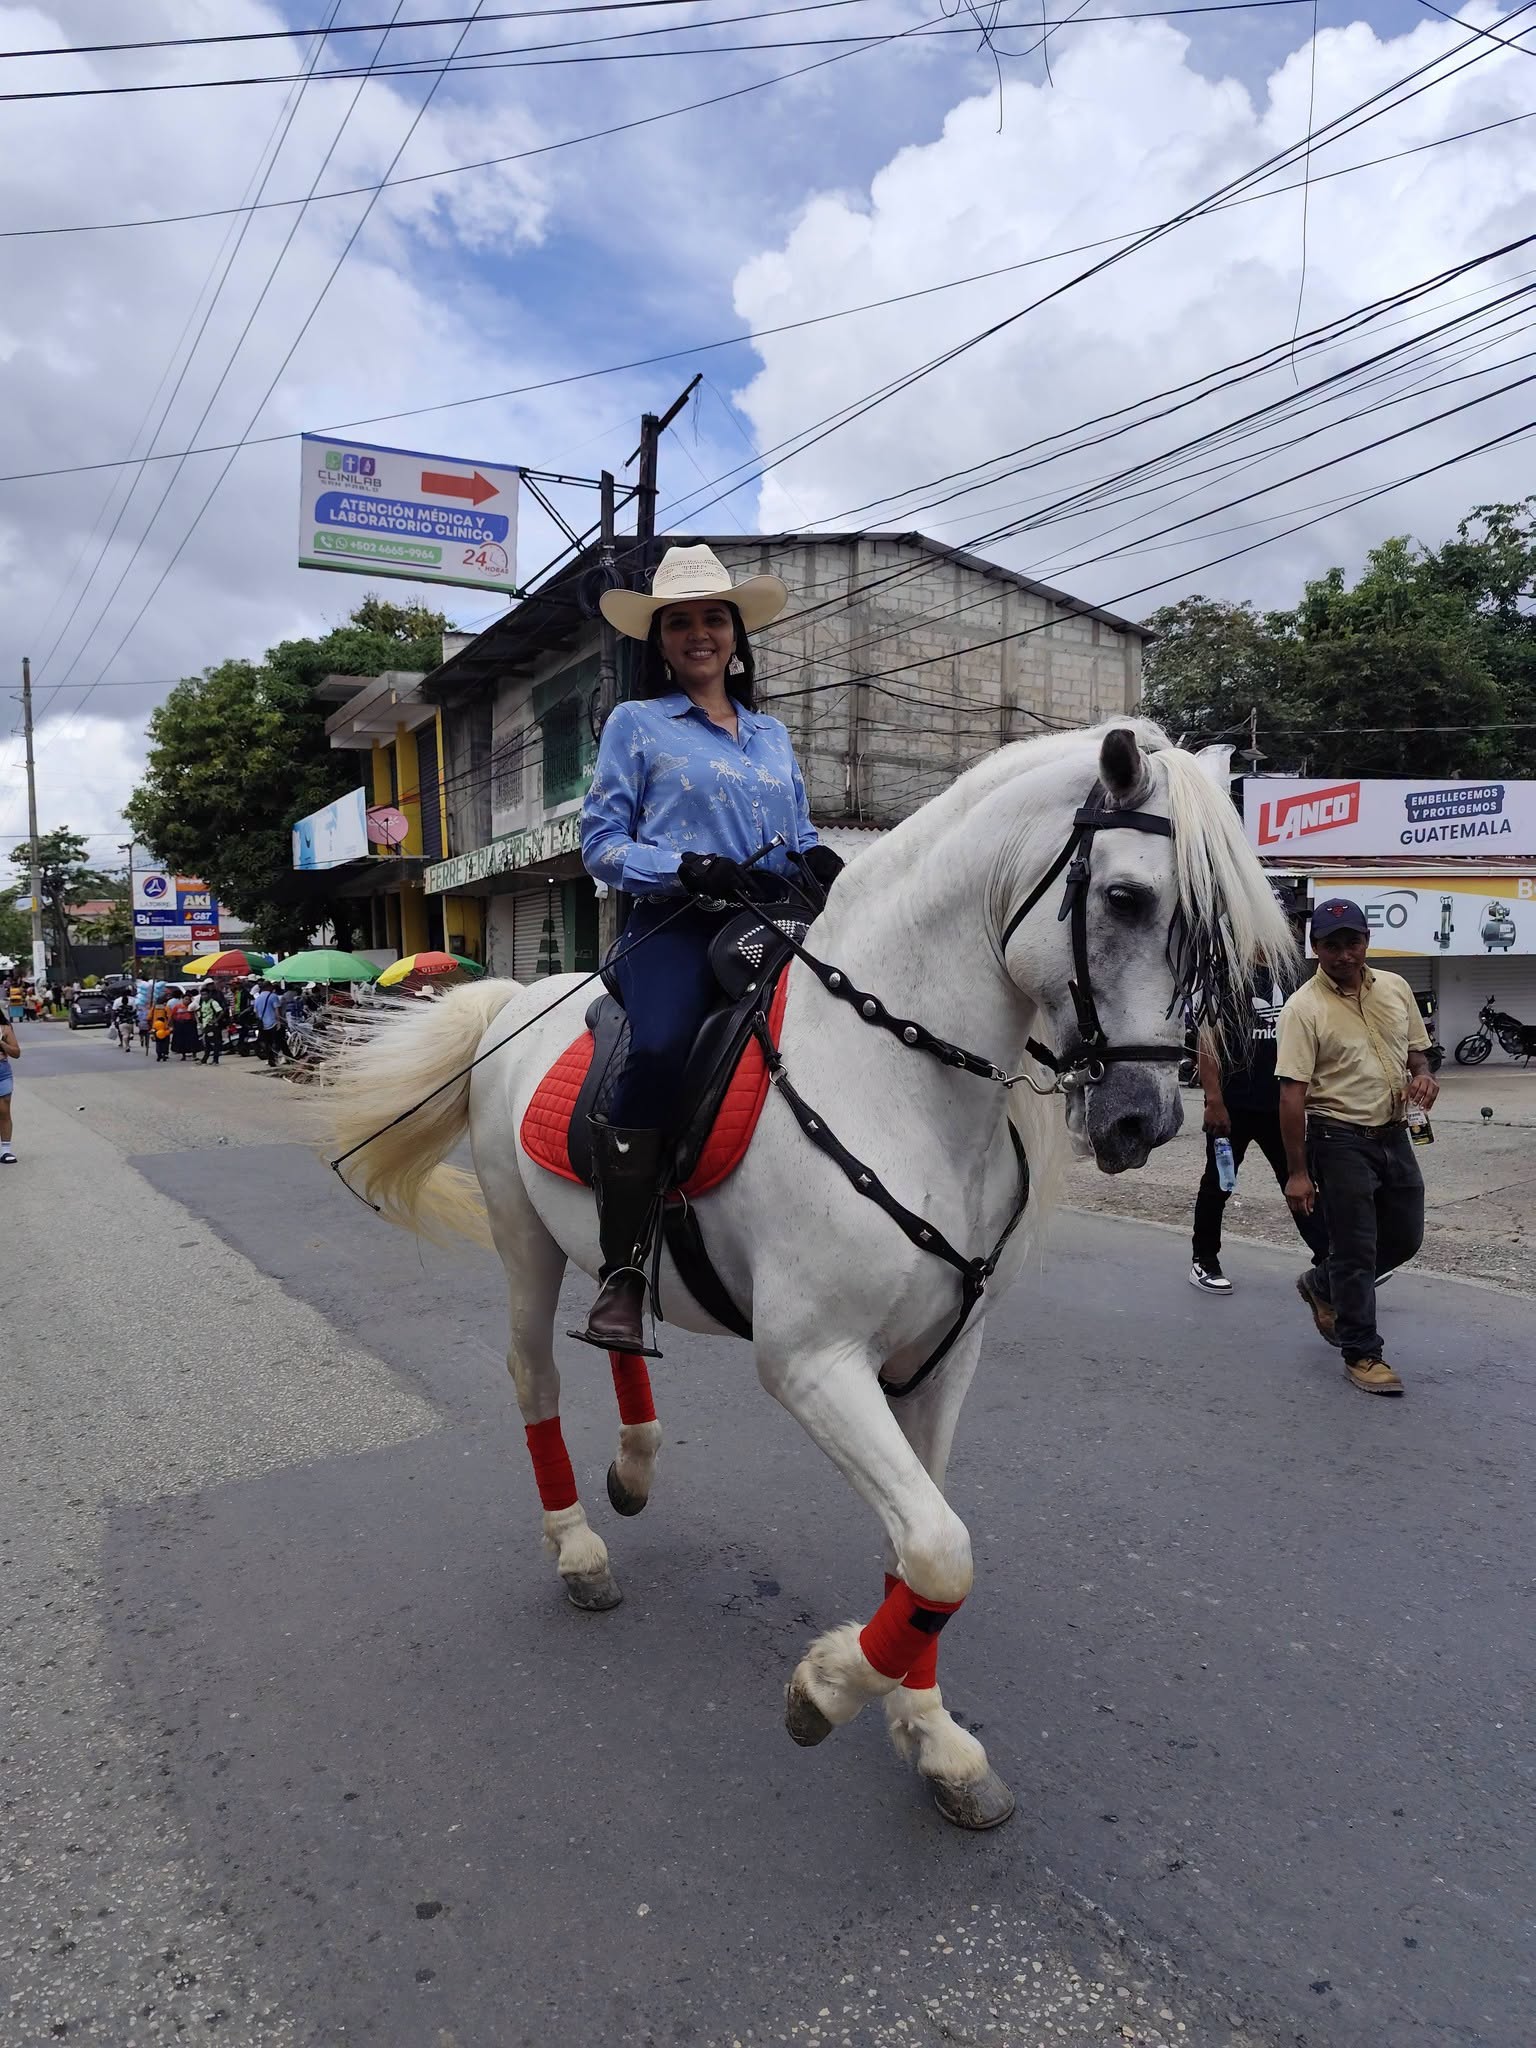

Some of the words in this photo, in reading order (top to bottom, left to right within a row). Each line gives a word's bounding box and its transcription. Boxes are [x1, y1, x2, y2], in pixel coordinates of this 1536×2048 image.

[318, 469, 382, 487] CLINILAB
[340, 497, 414, 519] ATENCIÓN
[417, 507, 473, 527] MÉDICA
[474, 517, 485, 529] Y
[330, 509, 432, 534] LABORATORIO
[435, 524, 494, 542] CLINICO
[350, 541, 377, 552] +502
[378, 543, 435, 560] 4665-9964
[462, 549, 488, 567] 24
[1411, 788, 1498, 806] EMBELLECEMOS
[1267, 794, 1351, 840] LANCO
[1412, 810, 1420, 819] Y
[1422, 802, 1497, 818] PROTEGEMOS
[1400, 819, 1512, 845] GUATEMALA
[1518, 879, 1536, 898] B
[1365, 903, 1408, 928] EO
